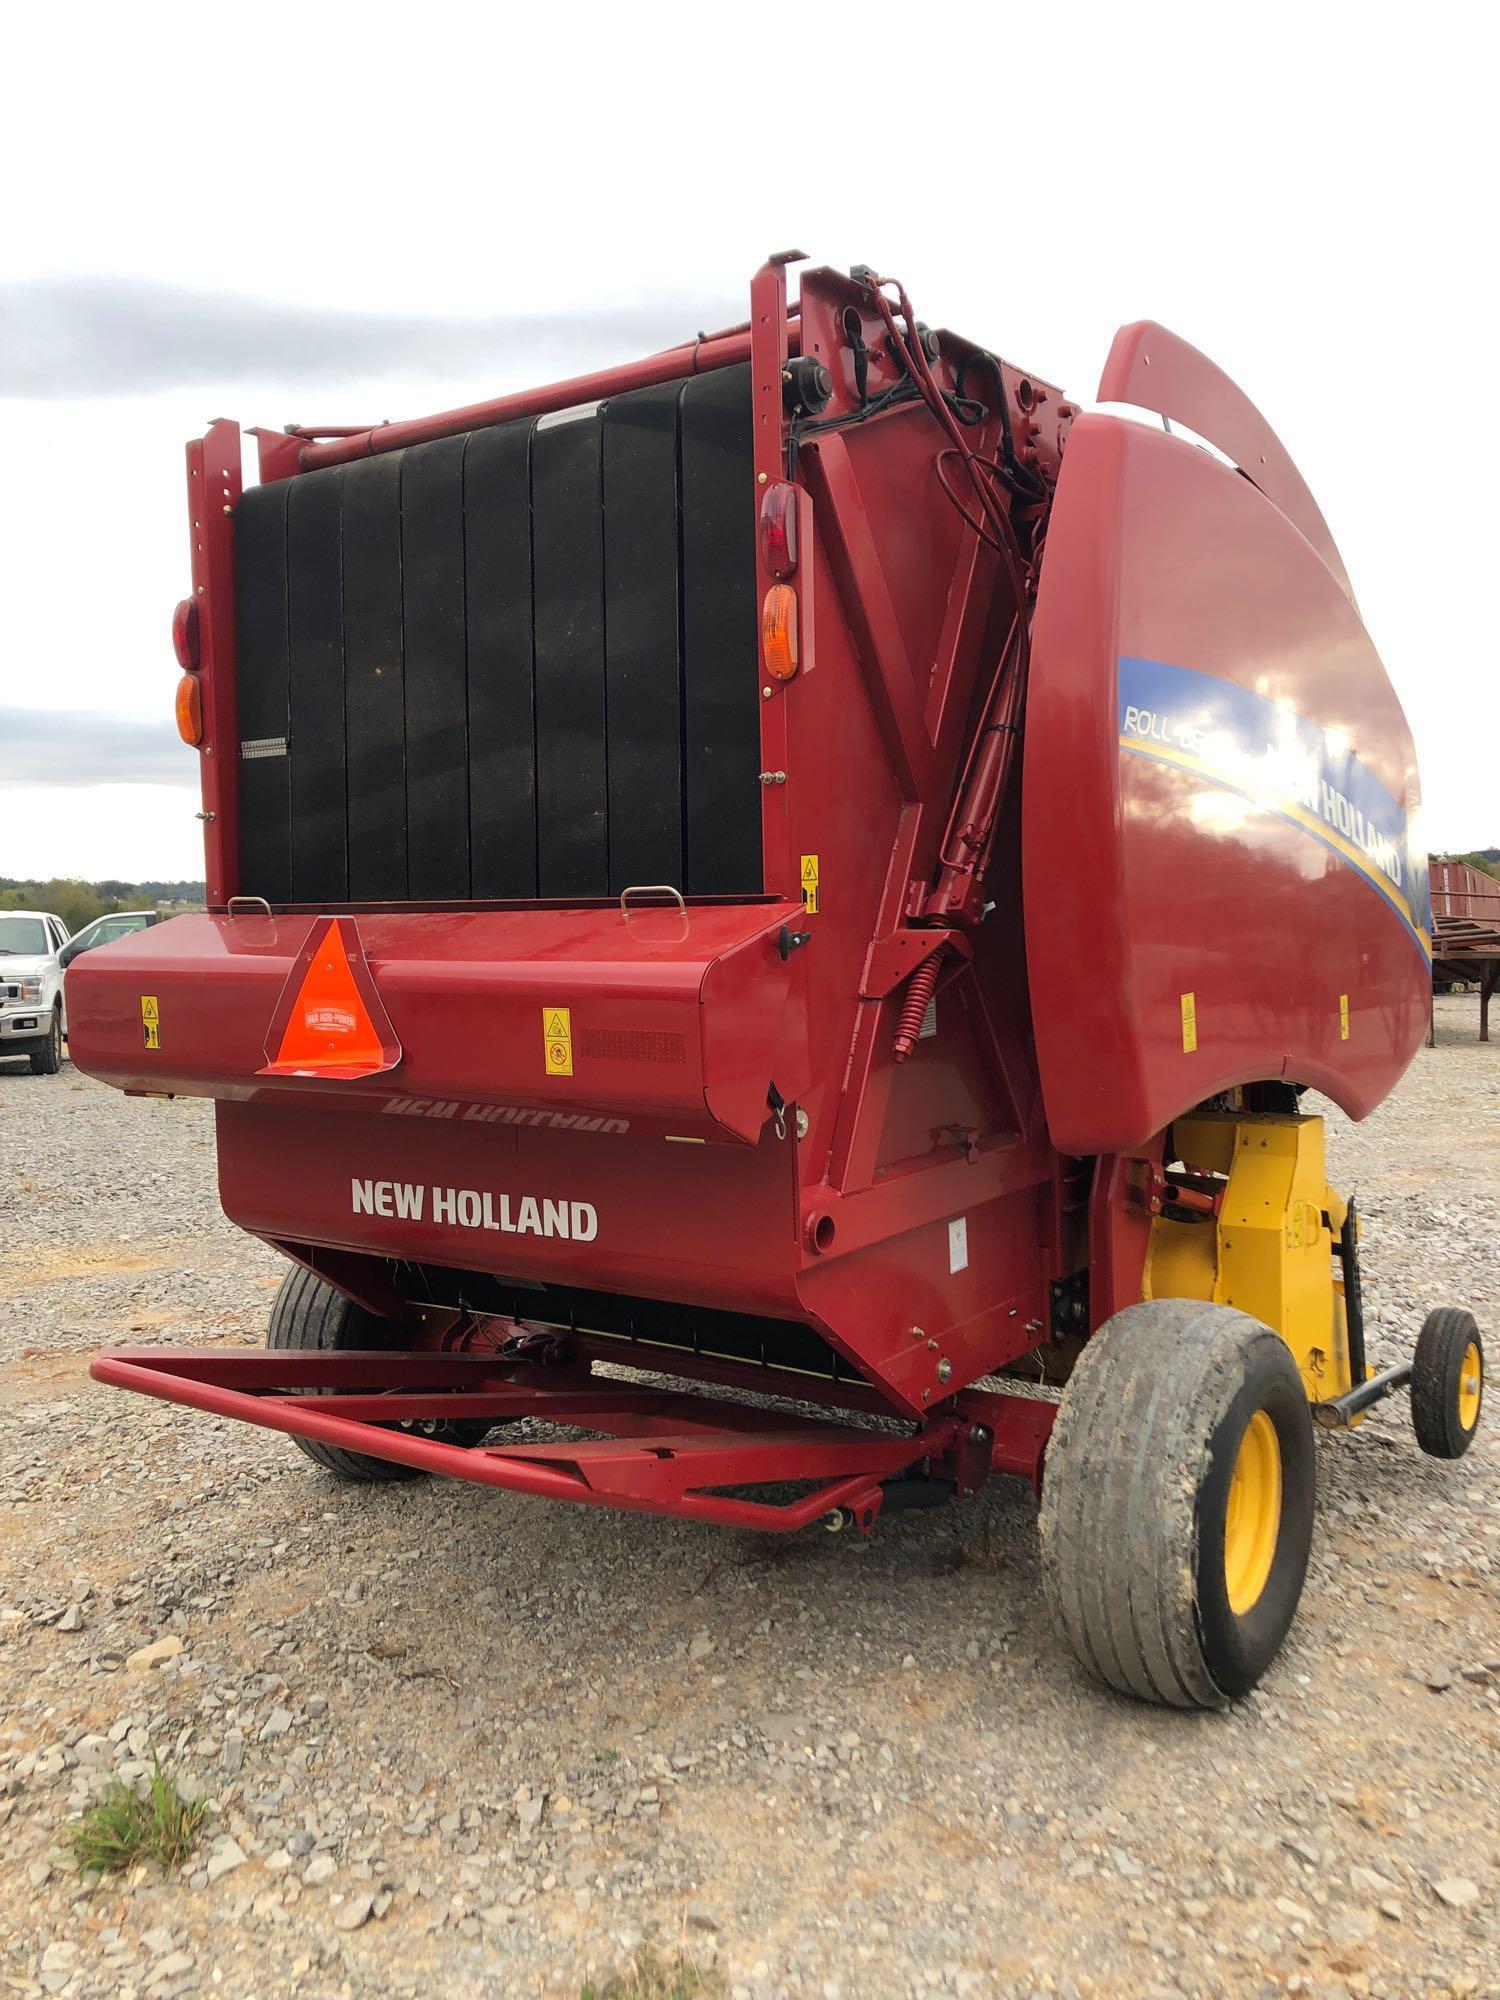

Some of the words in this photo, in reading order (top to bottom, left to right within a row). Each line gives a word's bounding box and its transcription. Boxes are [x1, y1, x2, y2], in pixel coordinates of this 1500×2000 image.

[1320, 778, 1402, 888] HOLLAND
[351, 1178, 424, 1221] NEW
[432, 1186, 598, 1242] HOLLAND
